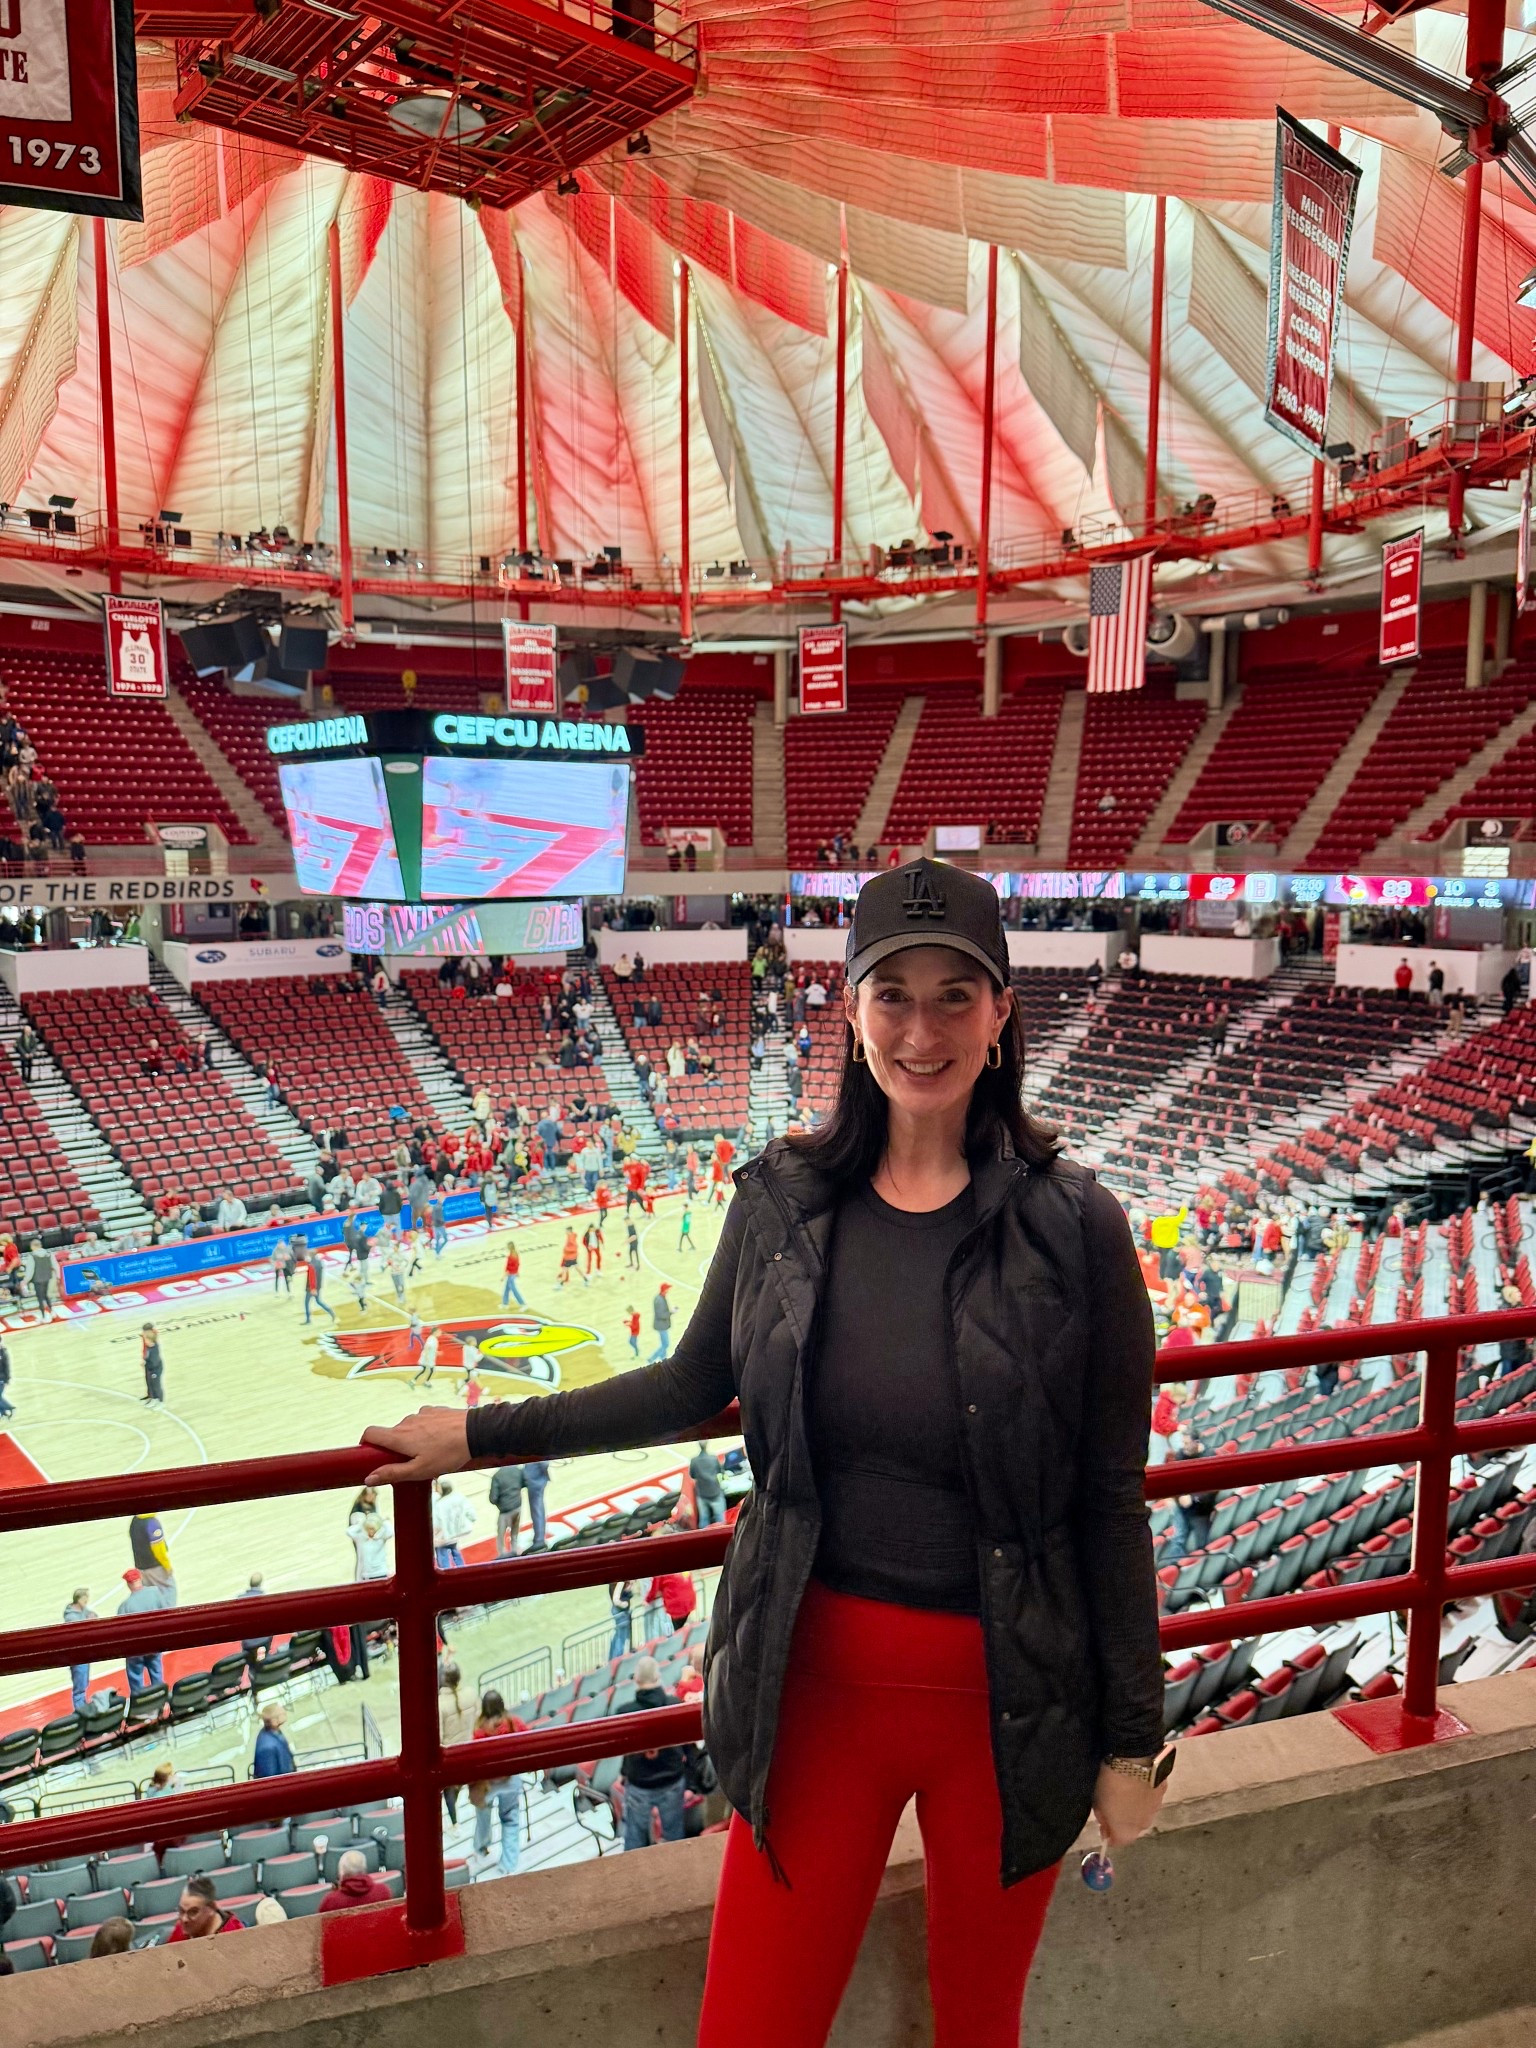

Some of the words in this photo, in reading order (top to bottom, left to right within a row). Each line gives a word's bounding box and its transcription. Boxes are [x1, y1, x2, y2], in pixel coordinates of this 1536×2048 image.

[9, 135, 102, 176] 1973
[1301, 194, 1325, 224] MILT
[111, 613, 158, 625] CHARLOTTE
[122, 622, 148, 631] LEWIS
[129, 653, 146, 665] 30
[267, 721, 317, 754] CEFCU
[316, 715, 369, 749] ARENA
[433, 714, 538, 749] CEFCU
[540, 721, 632, 752] ARENA
[0, 884, 33, 902] OF
[46, 883, 97, 900] THE
[110, 880, 235, 899] REDBIRDS
[902, 868, 946, 916] LA
[1444, 880, 1466, 897] 10
[249, 946, 297, 957] SUBARU
[0, 1291, 149, 1334] OUG
